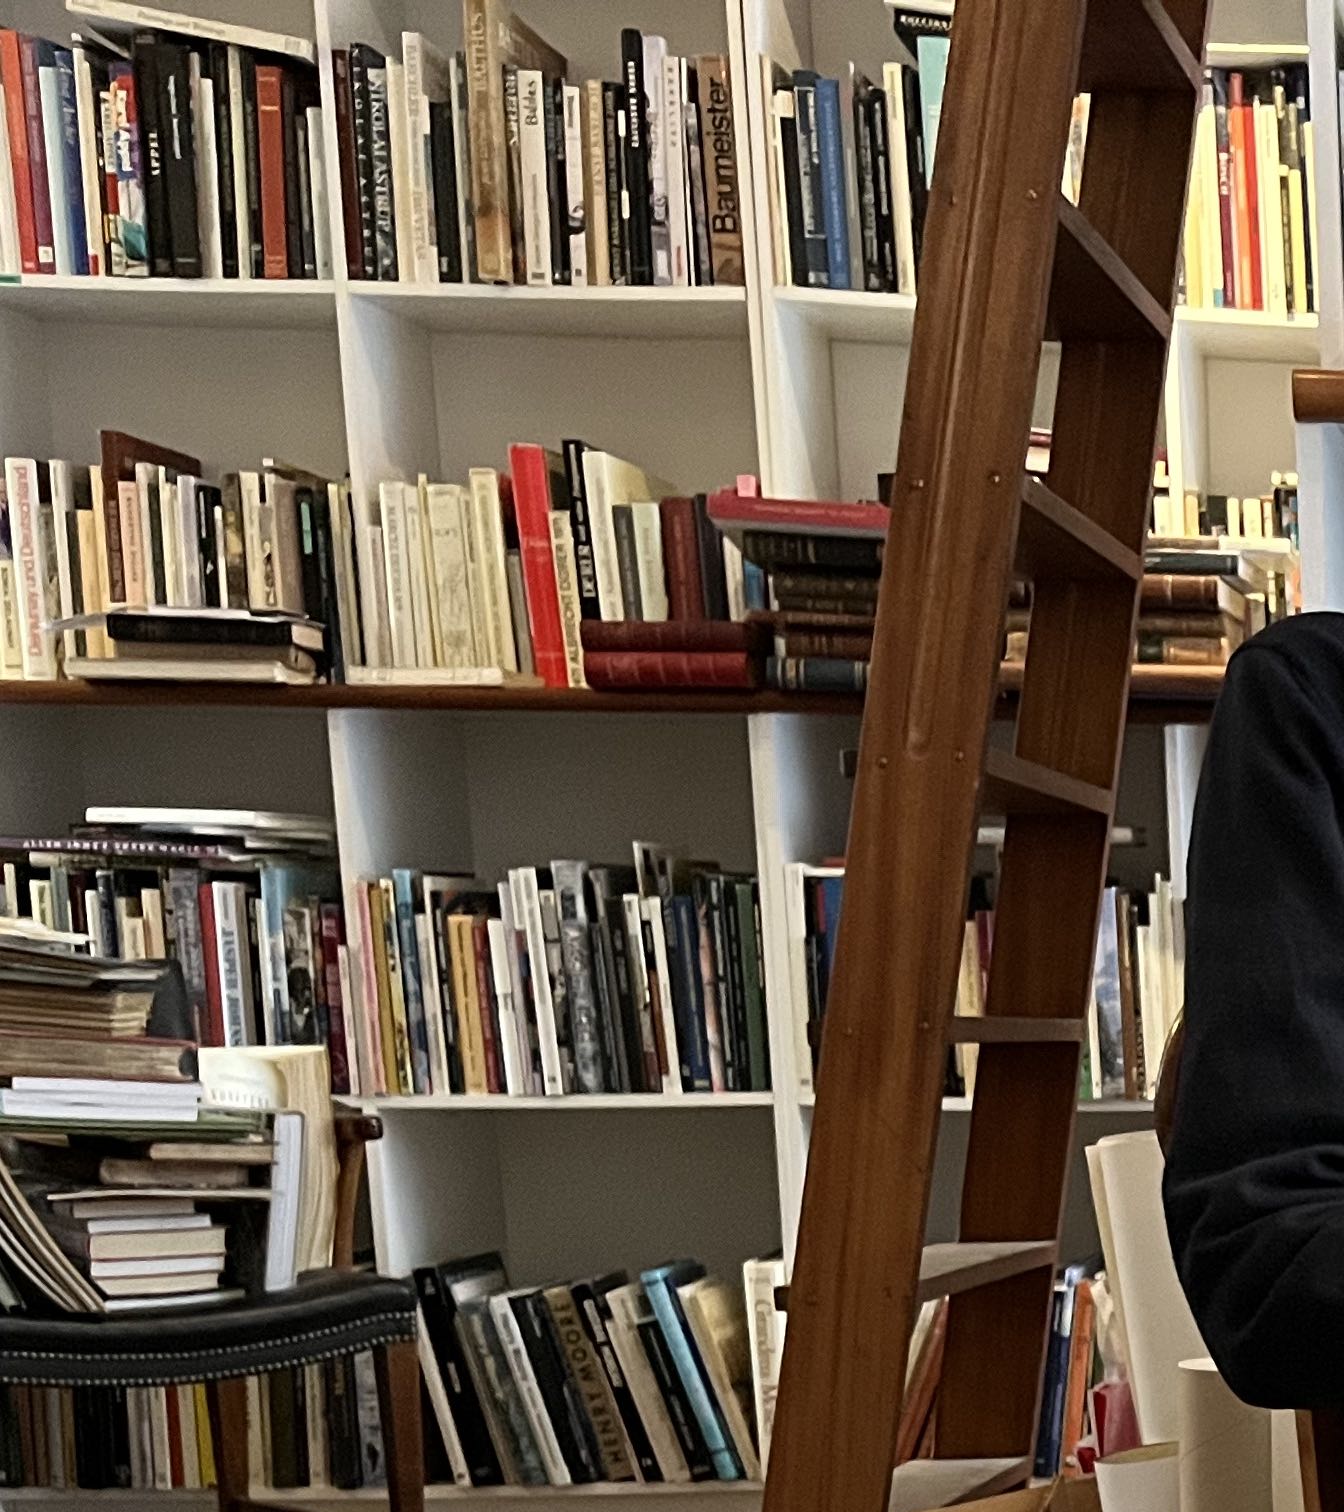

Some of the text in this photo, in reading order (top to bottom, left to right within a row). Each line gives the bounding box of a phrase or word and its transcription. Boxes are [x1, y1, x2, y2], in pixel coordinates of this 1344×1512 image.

[370, 79, 393, 233] NIKOLAI ASTRUP
[707, 78, 737, 235] Baumeister
[12, 466, 34, 558] Deutschland
